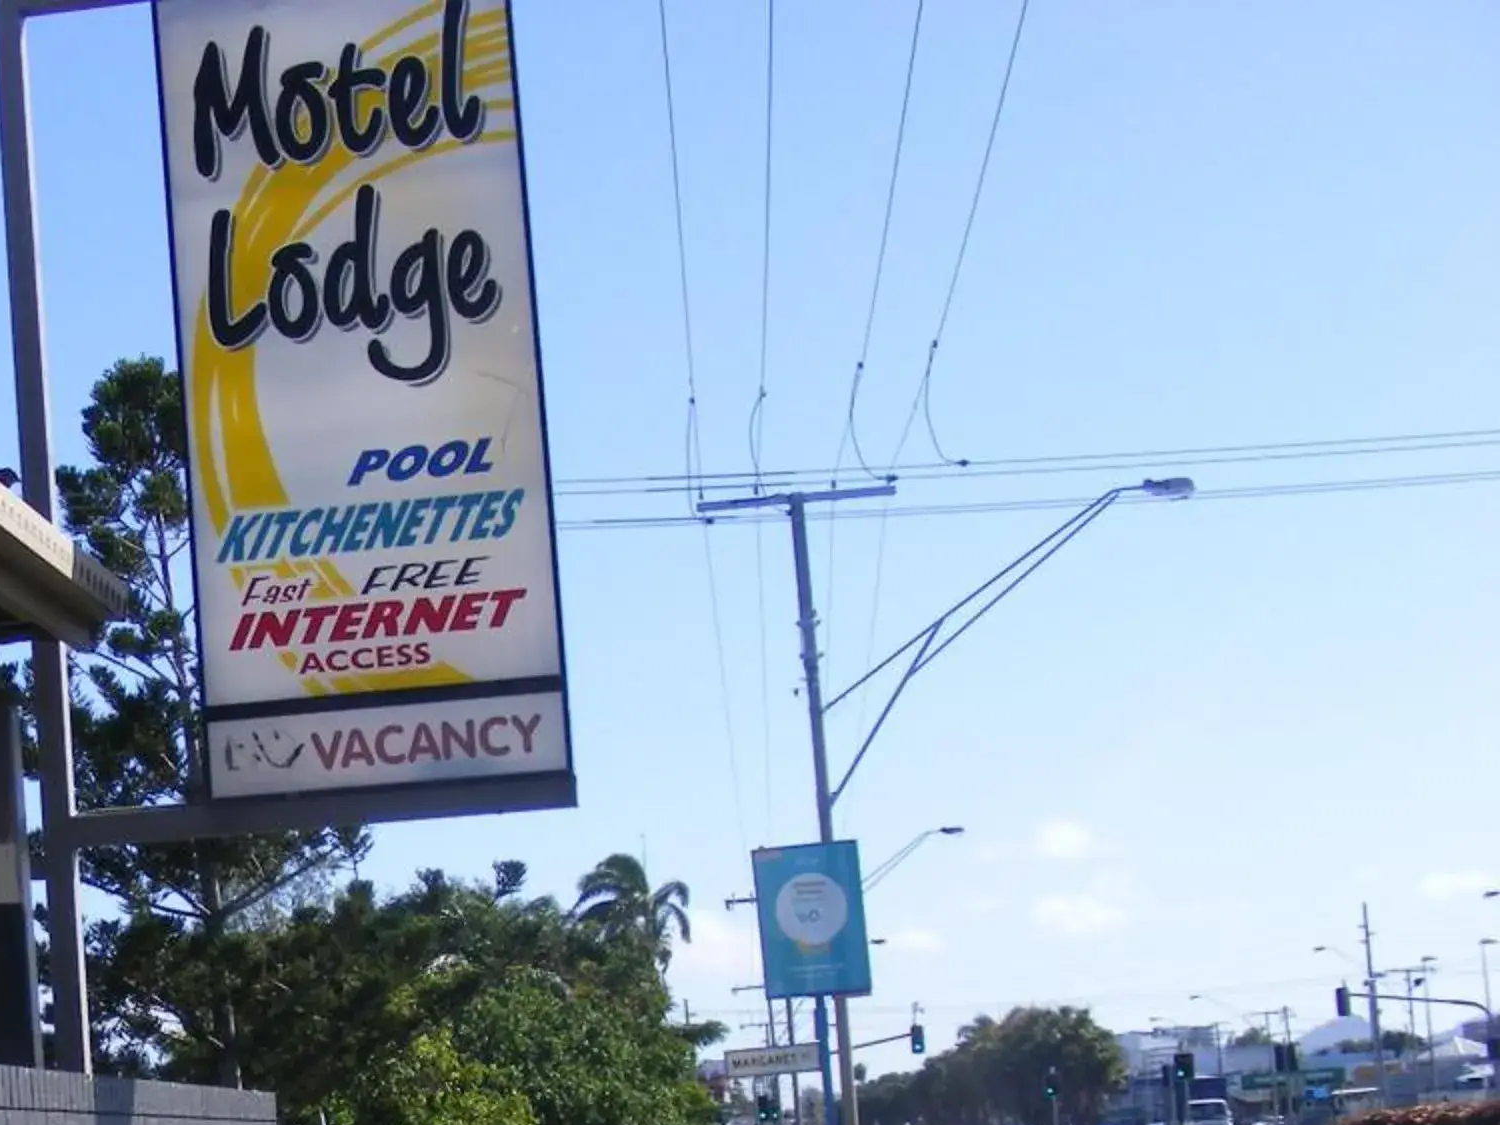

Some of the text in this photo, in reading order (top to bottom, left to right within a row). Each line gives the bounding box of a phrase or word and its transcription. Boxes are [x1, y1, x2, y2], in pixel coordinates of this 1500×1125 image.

[193, 0, 484, 180] Motel
[208, 184, 500, 385] Lodge
[347, 437, 493, 486] POOL
[217, 489, 525, 563] KITCHENETTES
[242, 556, 491, 607] Fast FREE
[229, 588, 527, 651] INTERNET
[299, 642, 431, 674] ACCESS
[310, 713, 542, 771] VACANCY
